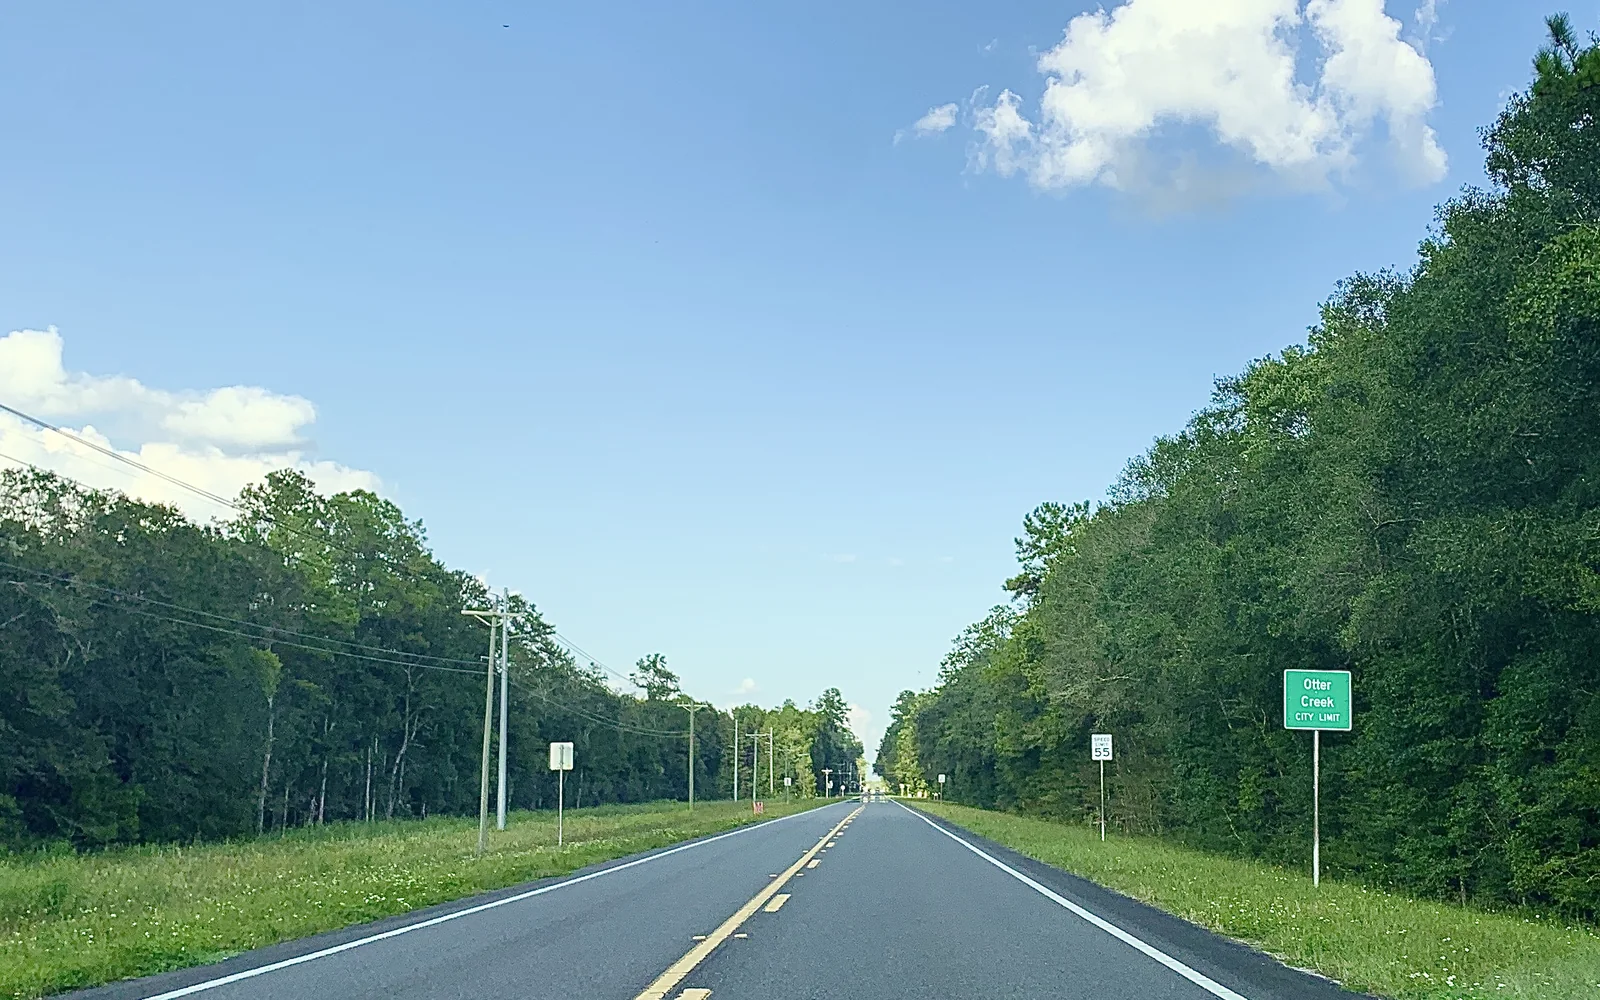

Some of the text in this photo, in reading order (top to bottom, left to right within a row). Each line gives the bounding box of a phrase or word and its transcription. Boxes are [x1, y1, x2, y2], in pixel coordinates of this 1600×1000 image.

[1303, 678, 1332, 691] Otter
[1301, 695, 1335, 708] Creek
[1295, 712, 1340, 722] CITY LIMIT
[1094, 747, 1110, 757] 55
